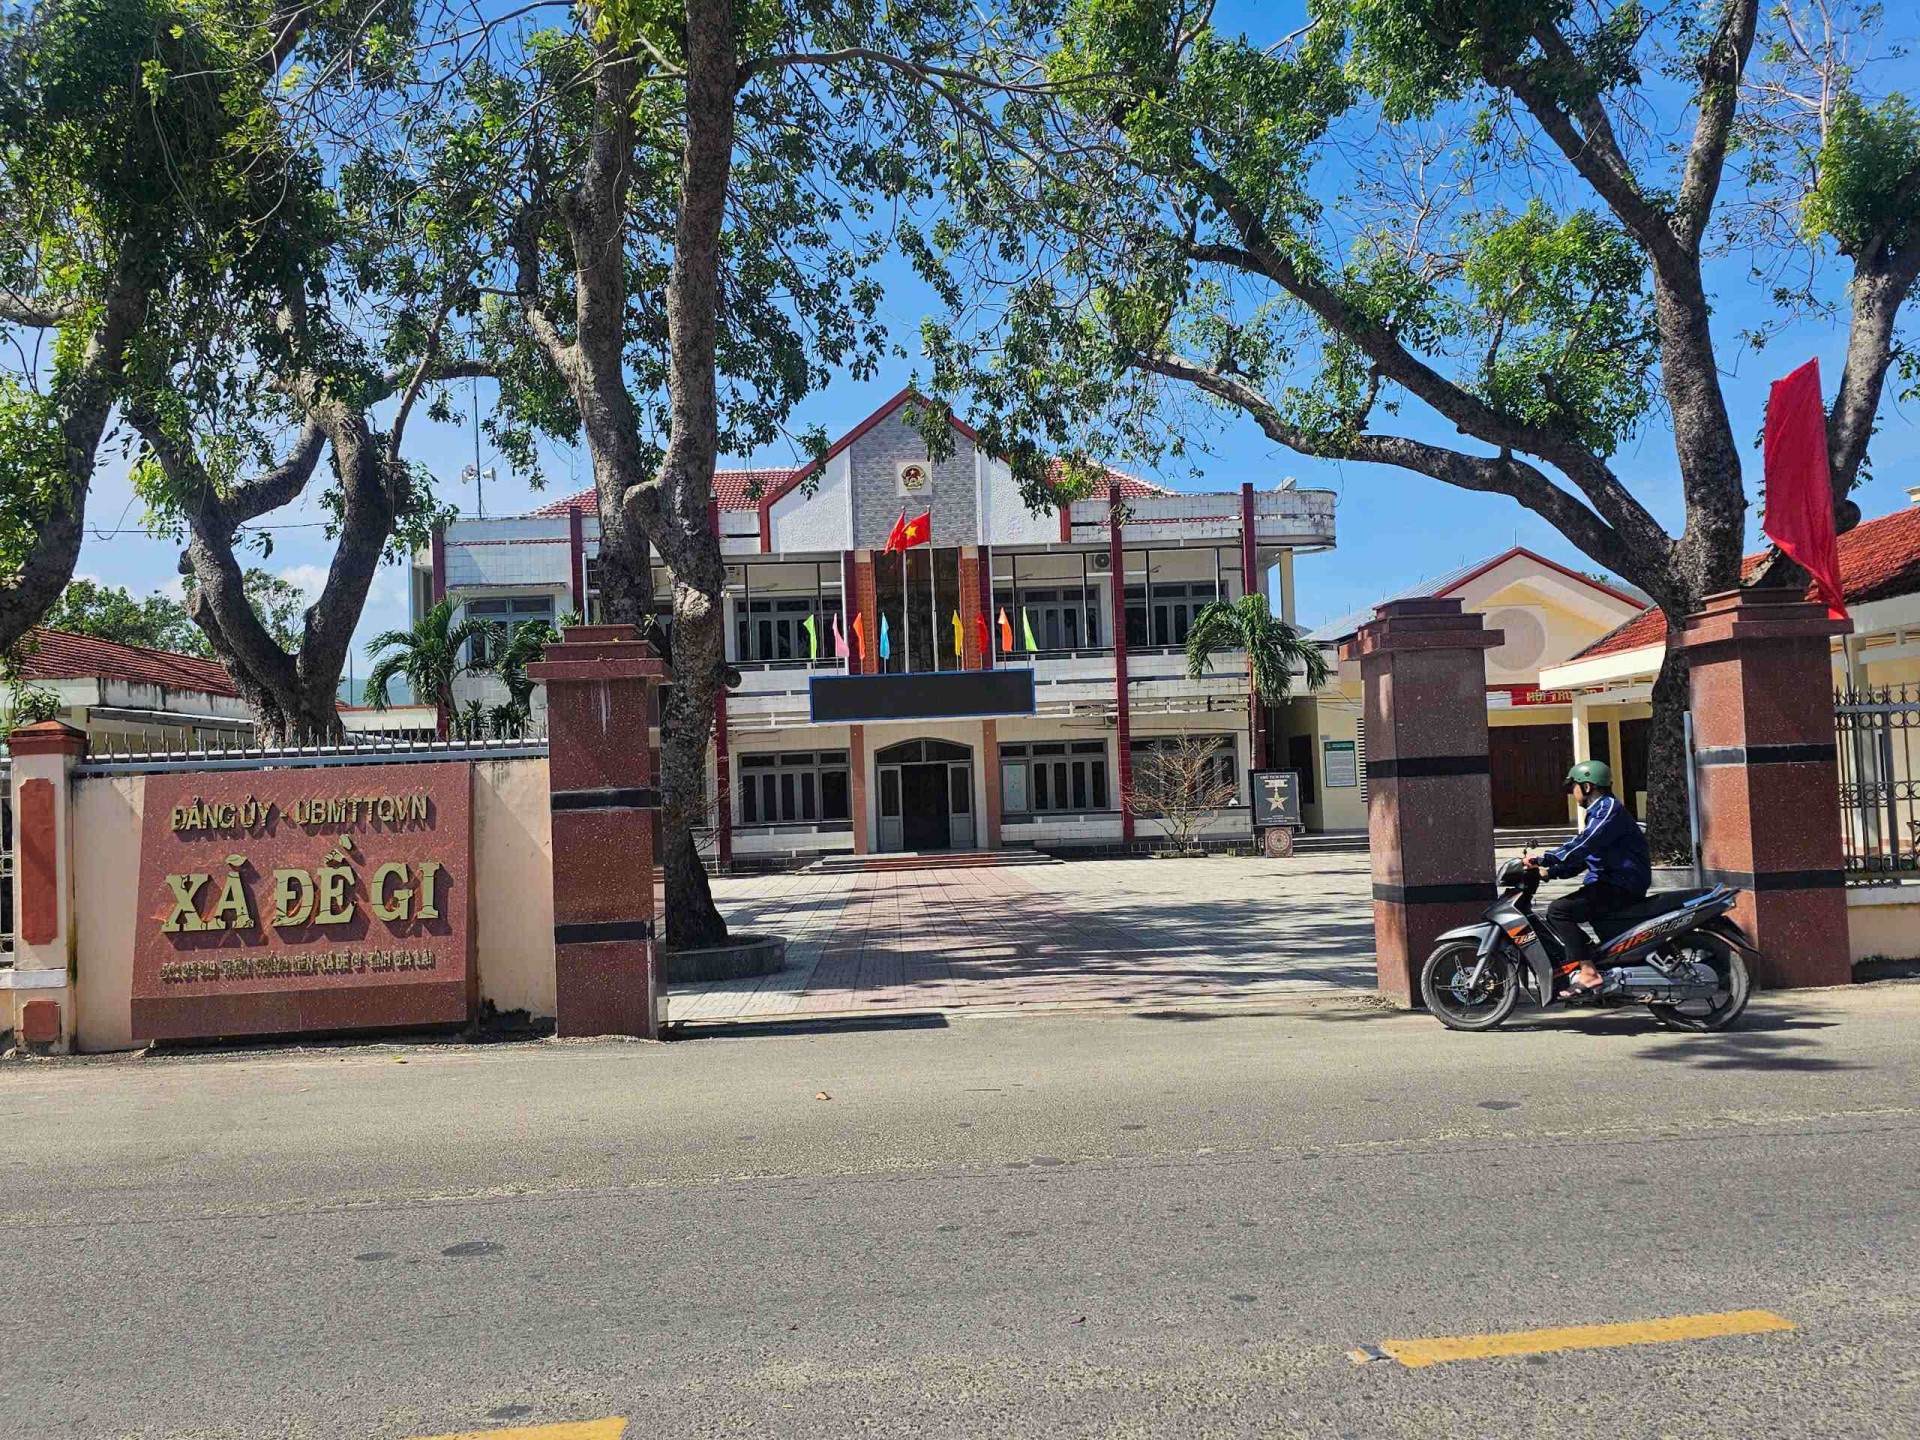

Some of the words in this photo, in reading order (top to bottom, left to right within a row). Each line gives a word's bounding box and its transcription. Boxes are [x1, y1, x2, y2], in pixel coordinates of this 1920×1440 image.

[171, 794, 235, 830] ĐẢNG
[239, 793, 274, 828] ỦY
[296, 795, 427, 824] UBMTTQVN
[161, 853, 254, 932] XÃ
[271, 834, 355, 927] ĐỀ
[371, 862, 440, 921] GI
